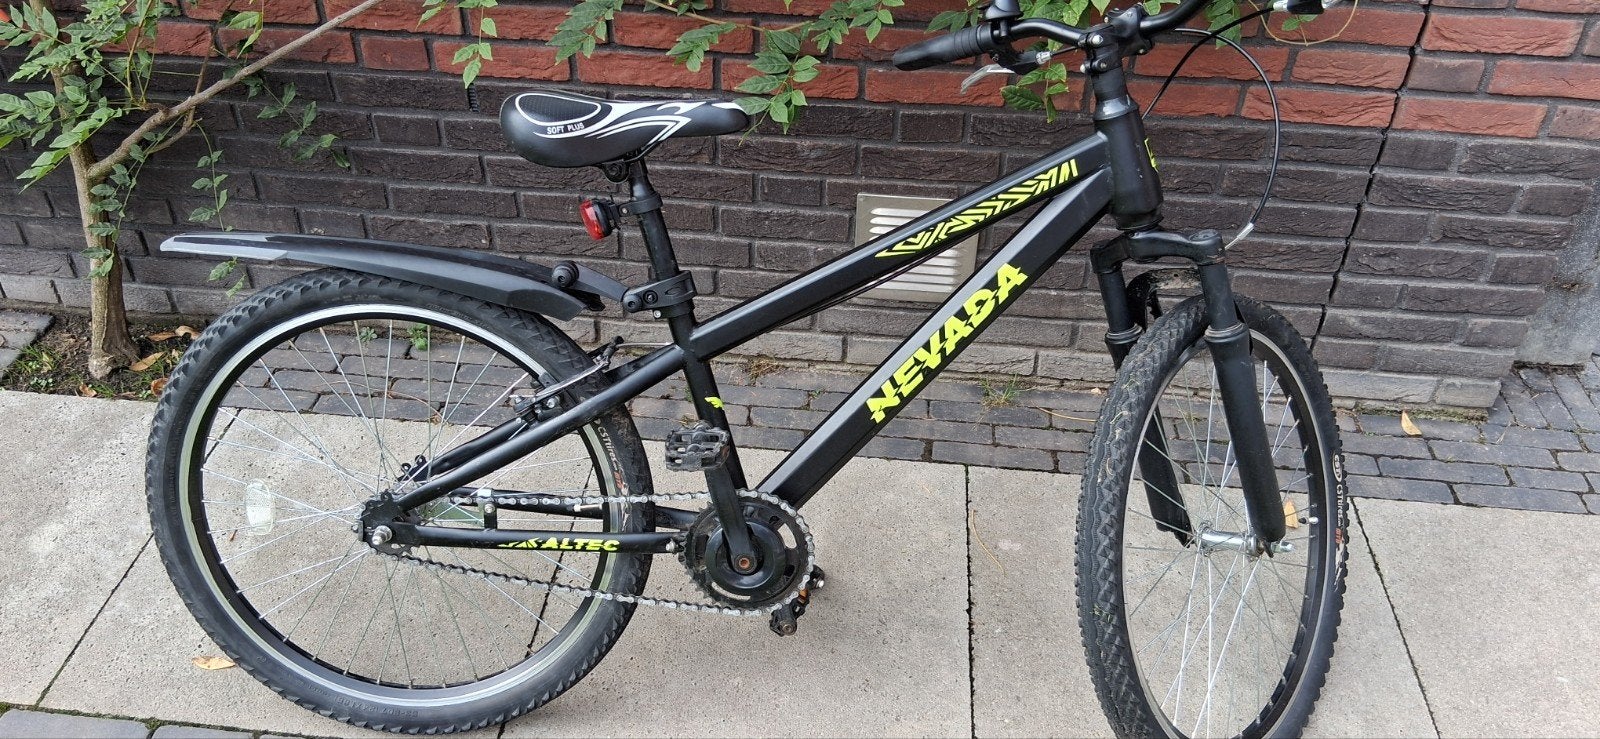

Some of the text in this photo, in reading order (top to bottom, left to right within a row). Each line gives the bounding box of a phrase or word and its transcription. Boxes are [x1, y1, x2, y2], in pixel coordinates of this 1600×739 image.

[547, 122, 584, 134] SOFT PLUS
[865, 262, 1029, 424] NEVADA
[540, 537, 620, 551] ALTEC
